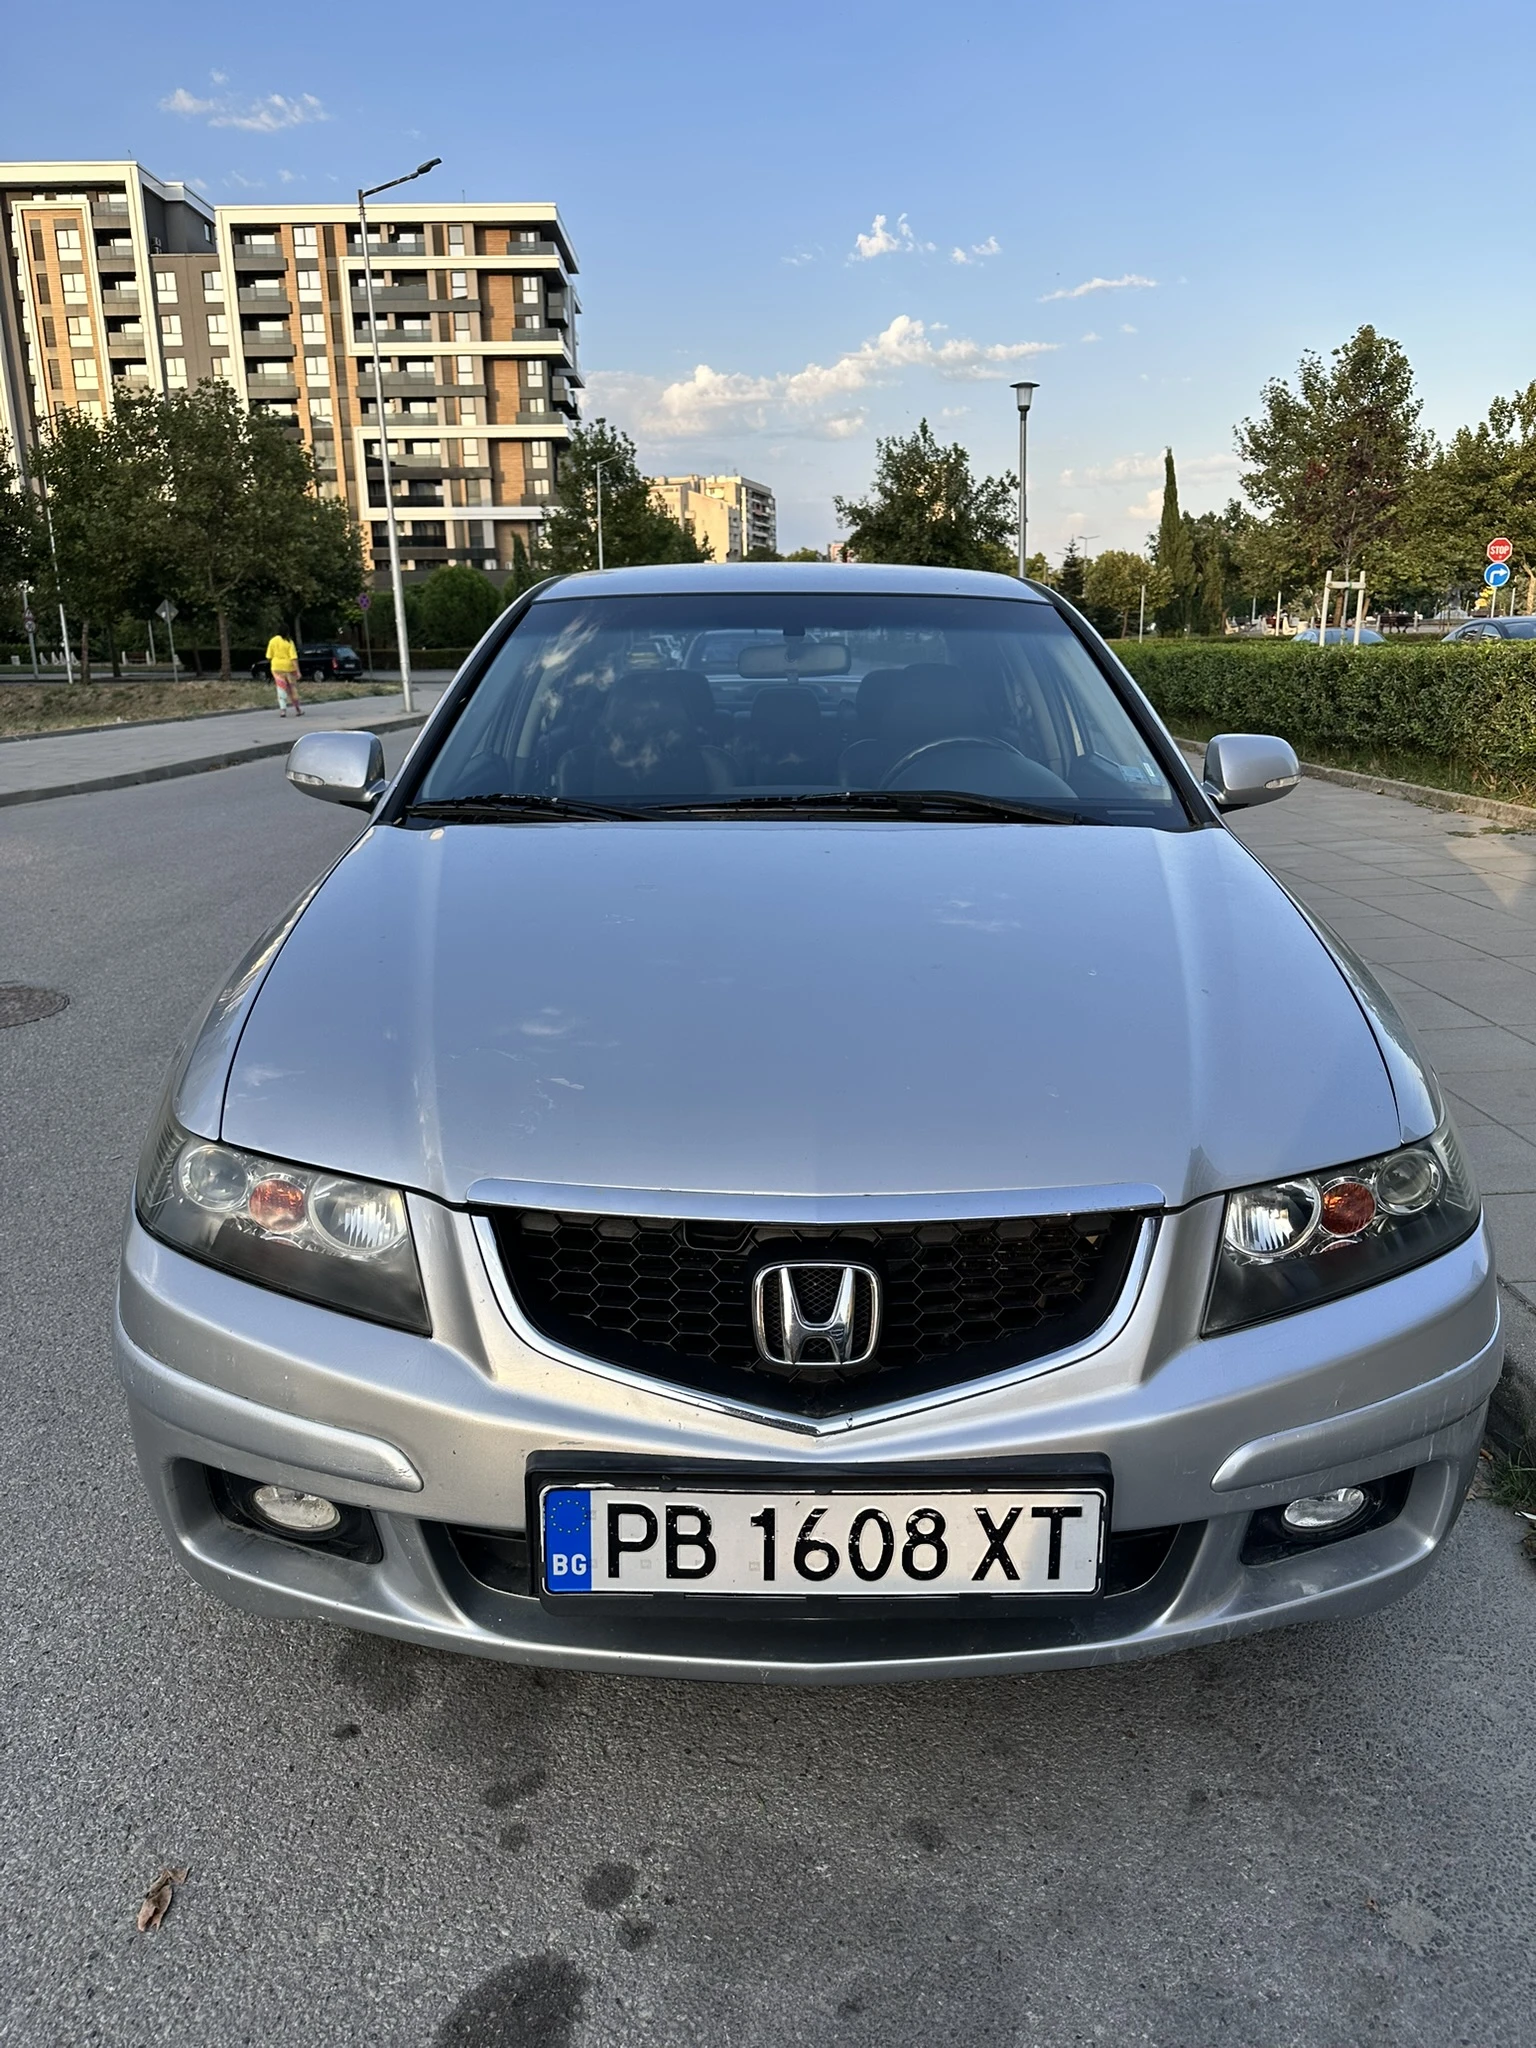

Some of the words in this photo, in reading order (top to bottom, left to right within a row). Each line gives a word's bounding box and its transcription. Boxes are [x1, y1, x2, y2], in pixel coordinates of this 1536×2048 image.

[1490, 545, 1509, 554] STOP
[607, 1502, 717, 1580] PB
[749, 1506, 949, 1582] 1608
[971, 1506, 1083, 1582] XT
[552, 1553, 587, 1576] BG
